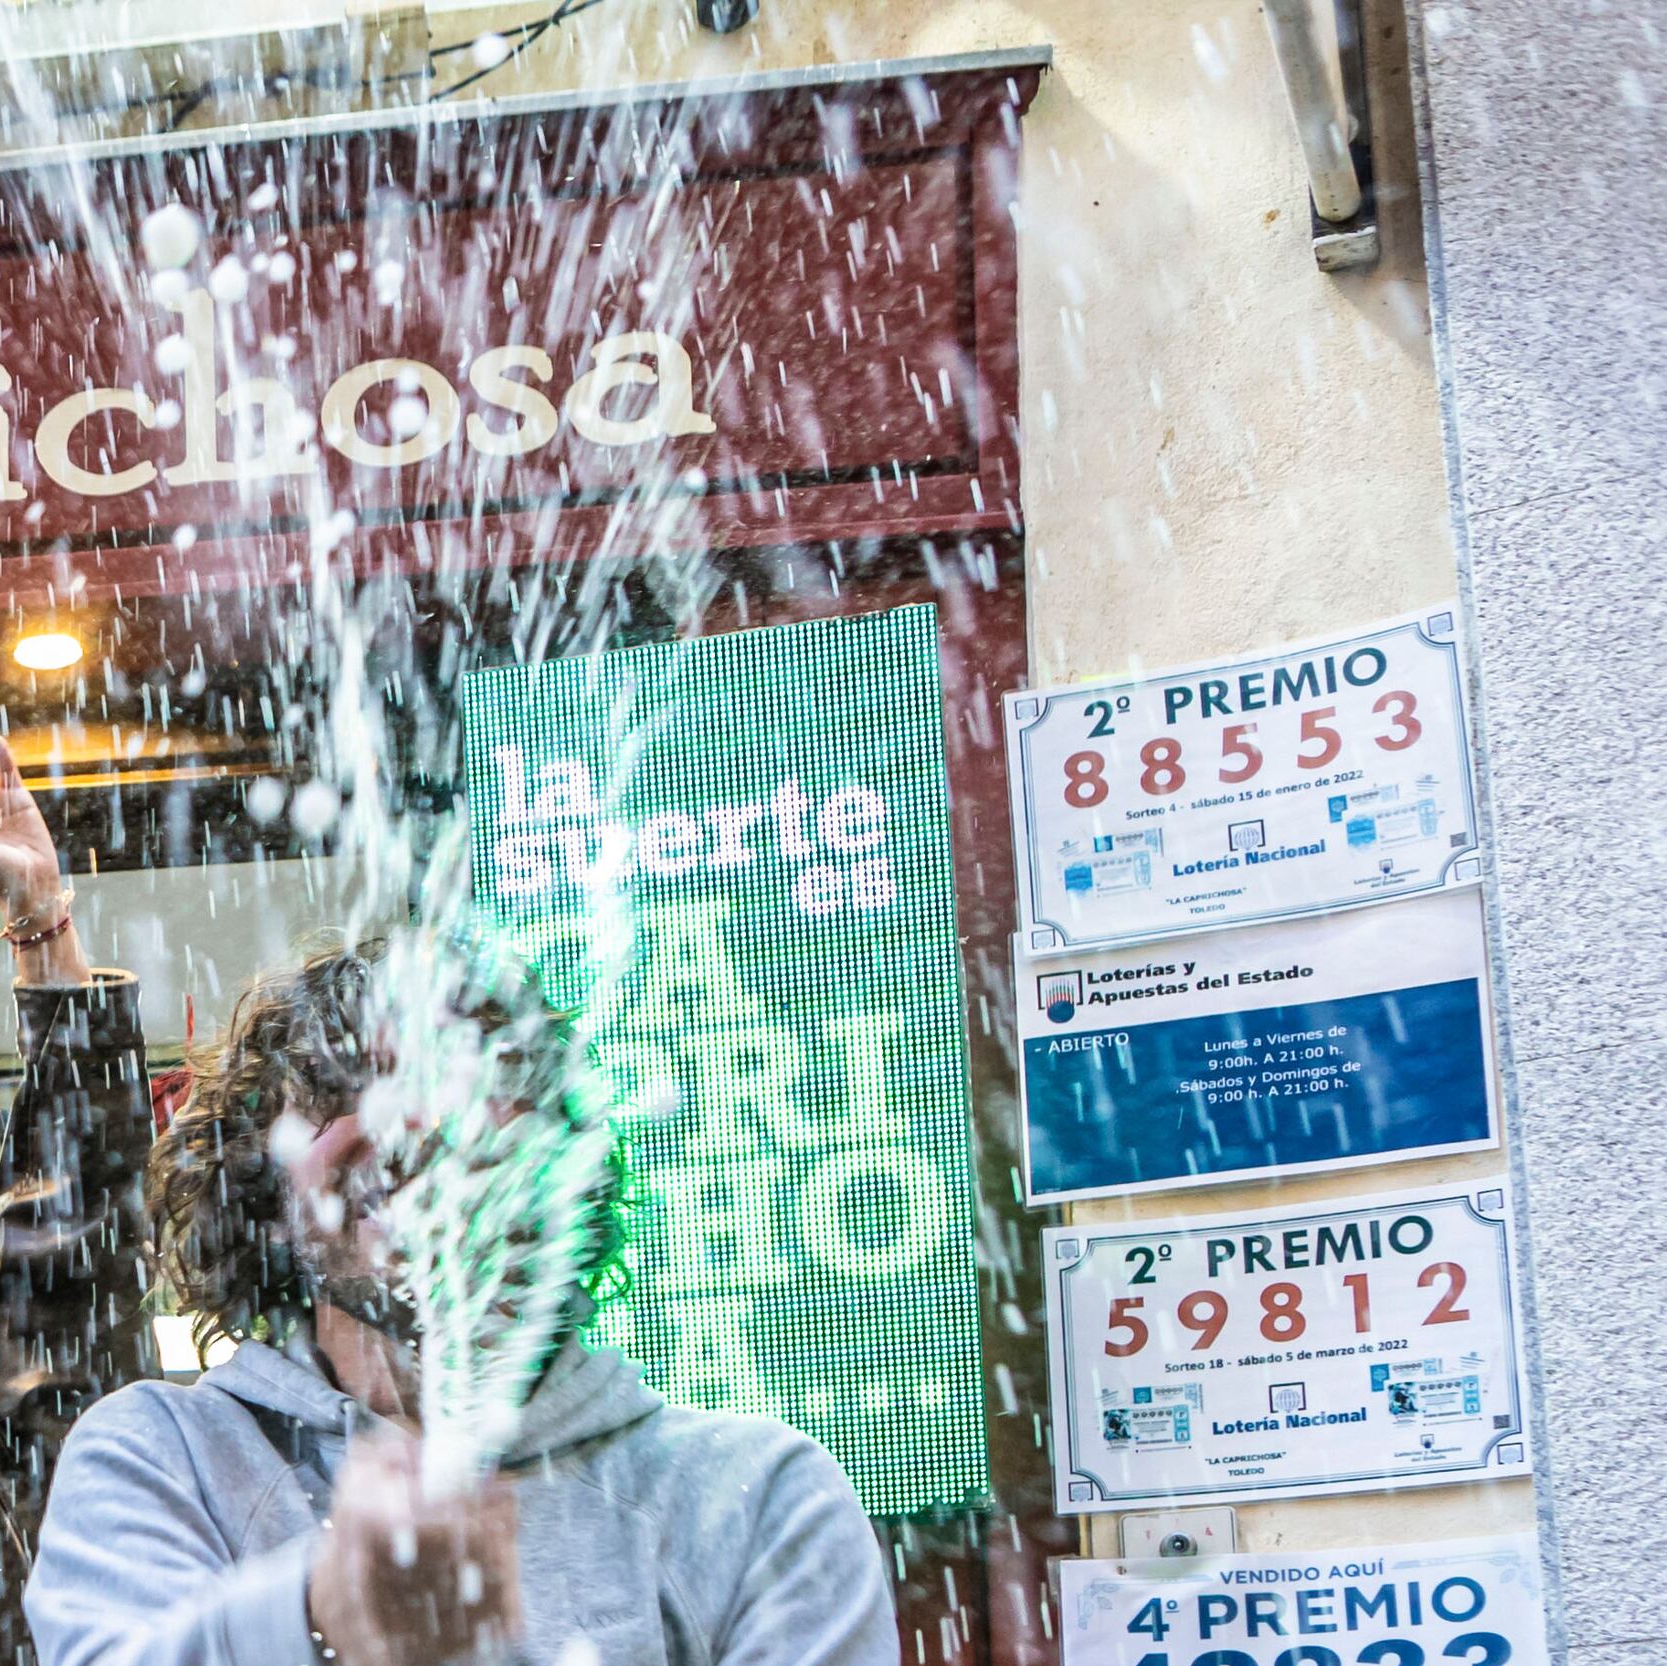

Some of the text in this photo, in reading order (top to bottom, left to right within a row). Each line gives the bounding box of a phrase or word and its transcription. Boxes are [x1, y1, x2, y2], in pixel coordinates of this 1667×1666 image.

[1084, 646, 1387, 738] 2º PREMIO
[1126, 805, 1166, 820] Sorteo
[1169, 803, 1176, 813] 4
[1191, 794, 1235, 810] sábado
[1239, 791, 1253, 802] 15
[1256, 787, 1272, 799] de
[1276, 782, 1311, 795] enero
[1315, 777, 1330, 787] de
[1334, 769, 1364, 784] 2022
[1173, 839, 1326, 877] Lotería Nacional
[1087, 960, 1196, 984] Loterías y
[1088, 964, 1314, 1005] Apuestas del Estado
[1048, 1032, 1129, 1054] ABIERTO
[1204, 1025, 1348, 1053] Lunes a Viernes de
[1208, 1044, 1344, 1071] 9:00h. A 21:00 h.
[1247, 1075, 1257, 1087] y
[1262, 1063, 1338, 1084] Domingos
[1342, 1059, 1362, 1074] de
[1207, 1076, 1349, 1104] 9:00 h. A 21:00 h.
[1124, 1214, 1434, 1285] 2º PREMIO
[1103, 1260, 1470, 1359] 59812
[1165, 1362, 1205, 1373] Sorteo
[1209, 1358, 1223, 1369] 18
[1238, 1354, 1282, 1367] sábado
[1286, 1353, 1293, 1362] 5
[1297, 1349, 1312, 1360] de
[1316, 1346, 1355, 1358] marzo
[1358, 1344, 1374, 1354] de
[1378, 1339, 1409, 1351] 2022
[1212, 1416, 1280, 1436] Lotería
[1285, 1406, 1367, 1429] Nacional
[1228, 1467, 1265, 1477] TOLEDO
[1219, 1558, 1385, 1585] VENDIDO AQUÍ
[1126, 1575, 1486, 1642] 4º PREMIO
